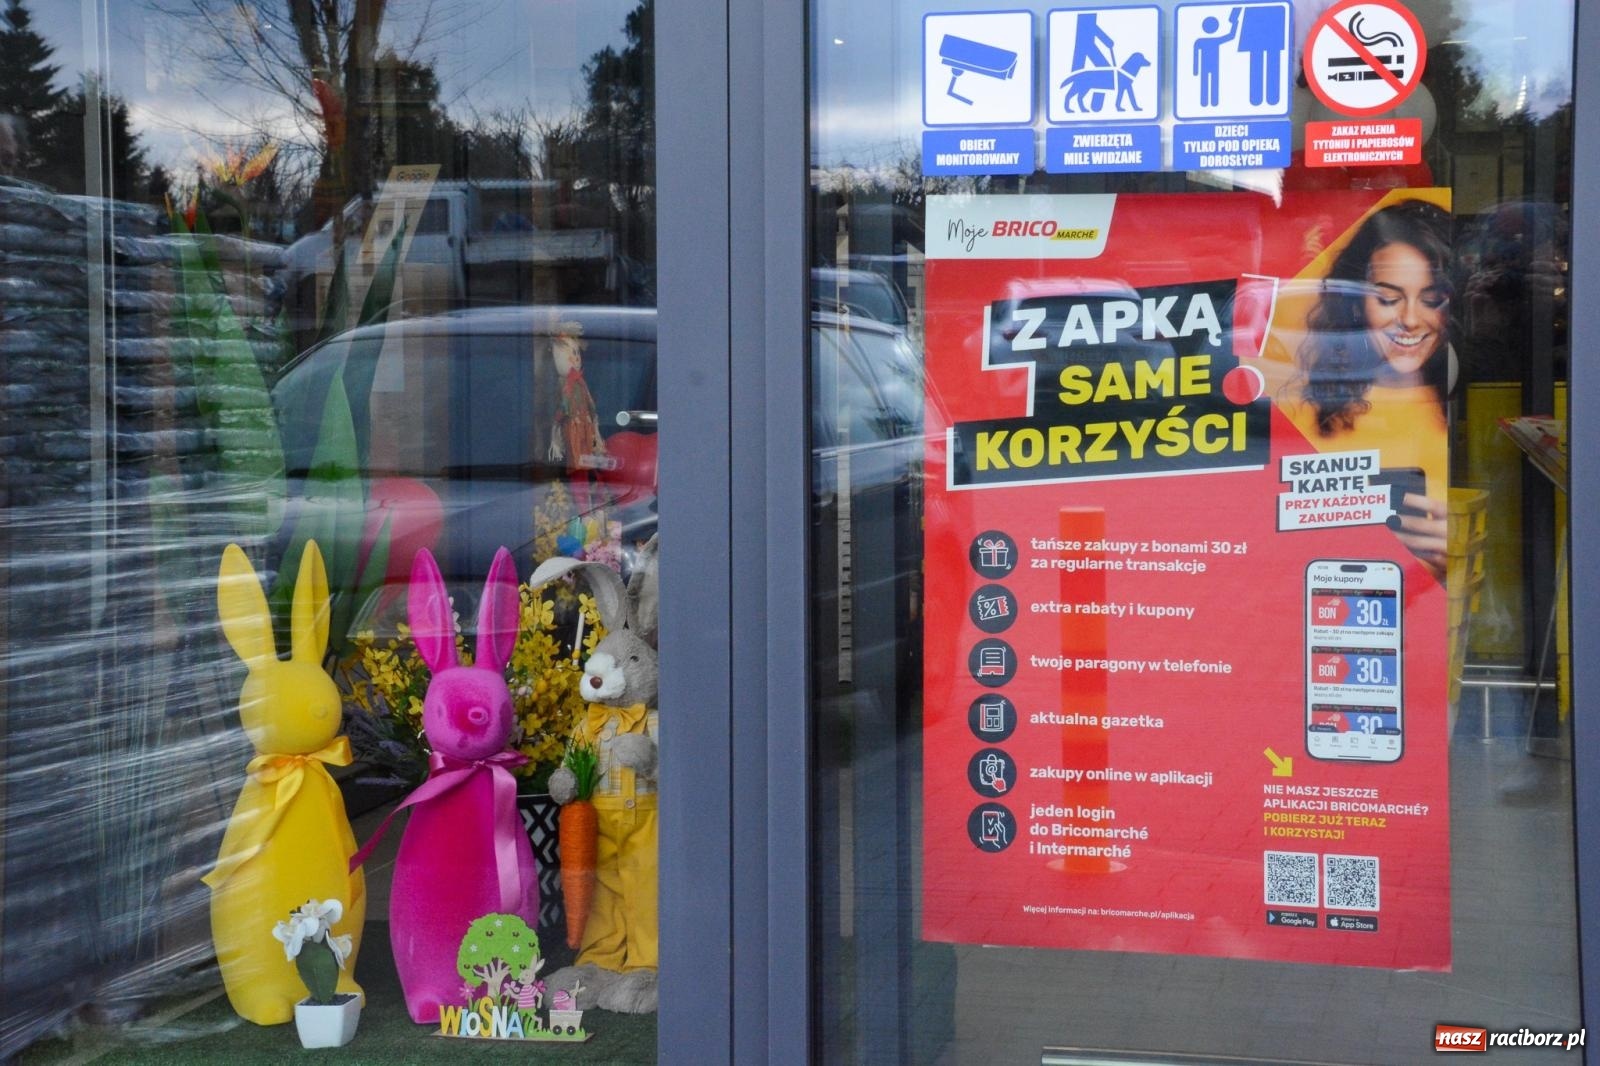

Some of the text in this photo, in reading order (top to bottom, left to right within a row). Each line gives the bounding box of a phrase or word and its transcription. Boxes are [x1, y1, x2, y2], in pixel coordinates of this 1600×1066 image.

[1215, 125, 1248, 138] DZIECI
[1332, 124, 1396, 137] ZAKAZ PALENIA
[959, 139, 996, 151] OBIEKT
[1073, 133, 1132, 149] ZWIERZĘTA
[1183, 138, 1280, 153] TYLKO POD OPIEKĄ
[1313, 136, 1414, 150] TYTONIU I PAPIEROSÓW
[936, 153, 1020, 167] MONITOROWANY
[1064, 151, 1142, 166] MILE WIDZANE
[1200, 154, 1263, 168] DOROSŁYCH
[1323, 150, 1403, 163] ELEKTRONICZNYCH
[947, 218, 988, 253] Moje
[991, 220, 1058, 237] BRICO
[1011, 292, 1223, 352] Z APKĄ
[1058, 354, 1212, 406] SAME
[975, 404, 1247, 472] KORZYŚCI
[1289, 456, 1372, 476] SKANUJ
[1298, 475, 1364, 494] KARTĘ
[1285, 494, 1386, 510] PRZY KAŻDYCH
[1298, 509, 1372, 524] ZAKUPACH
[1030, 537, 1248, 555] tańsze zakupy z bonami 30 zł
[1030, 557, 1207, 575] za regularne transakcje
[1313, 575, 1364, 584] Moje kupony
[1030, 602, 1195, 620] extra rabaty i kupony
[1318, 607, 1336, 619] BON
[1356, 599, 1382, 625] 30
[1030, 655, 1232, 674] twoje paragony w telefonie
[1318, 664, 1336, 677] BON
[1356, 657, 1382, 683] 30
[1029, 711, 1164, 731] aktualna gazetka
[1029, 766, 1213, 787] zakupy online w aplikacji
[1264, 784, 1379, 799] NIE MASZ JESZCZE
[1029, 804, 1115, 821] jeden login
[1263, 798, 1429, 816] APLIKACJI BRICOMARCHÉ?
[1264, 812, 1386, 828] POBIERZ JUŻ TERAZ
[1029, 823, 1149, 840] do Bricomarché
[1270, 826, 1345, 840] KORZYSTAJ!
[1029, 842, 1131, 858] i Intermarché
[1023, 904, 1195, 921] Więcej informacji na: bricomarche.pl/aplikacja
[1281, 916, 1315, 927] Google Play
[1340, 921, 1374, 930] App Store
[440, 996, 525, 1039] WIOSNA
